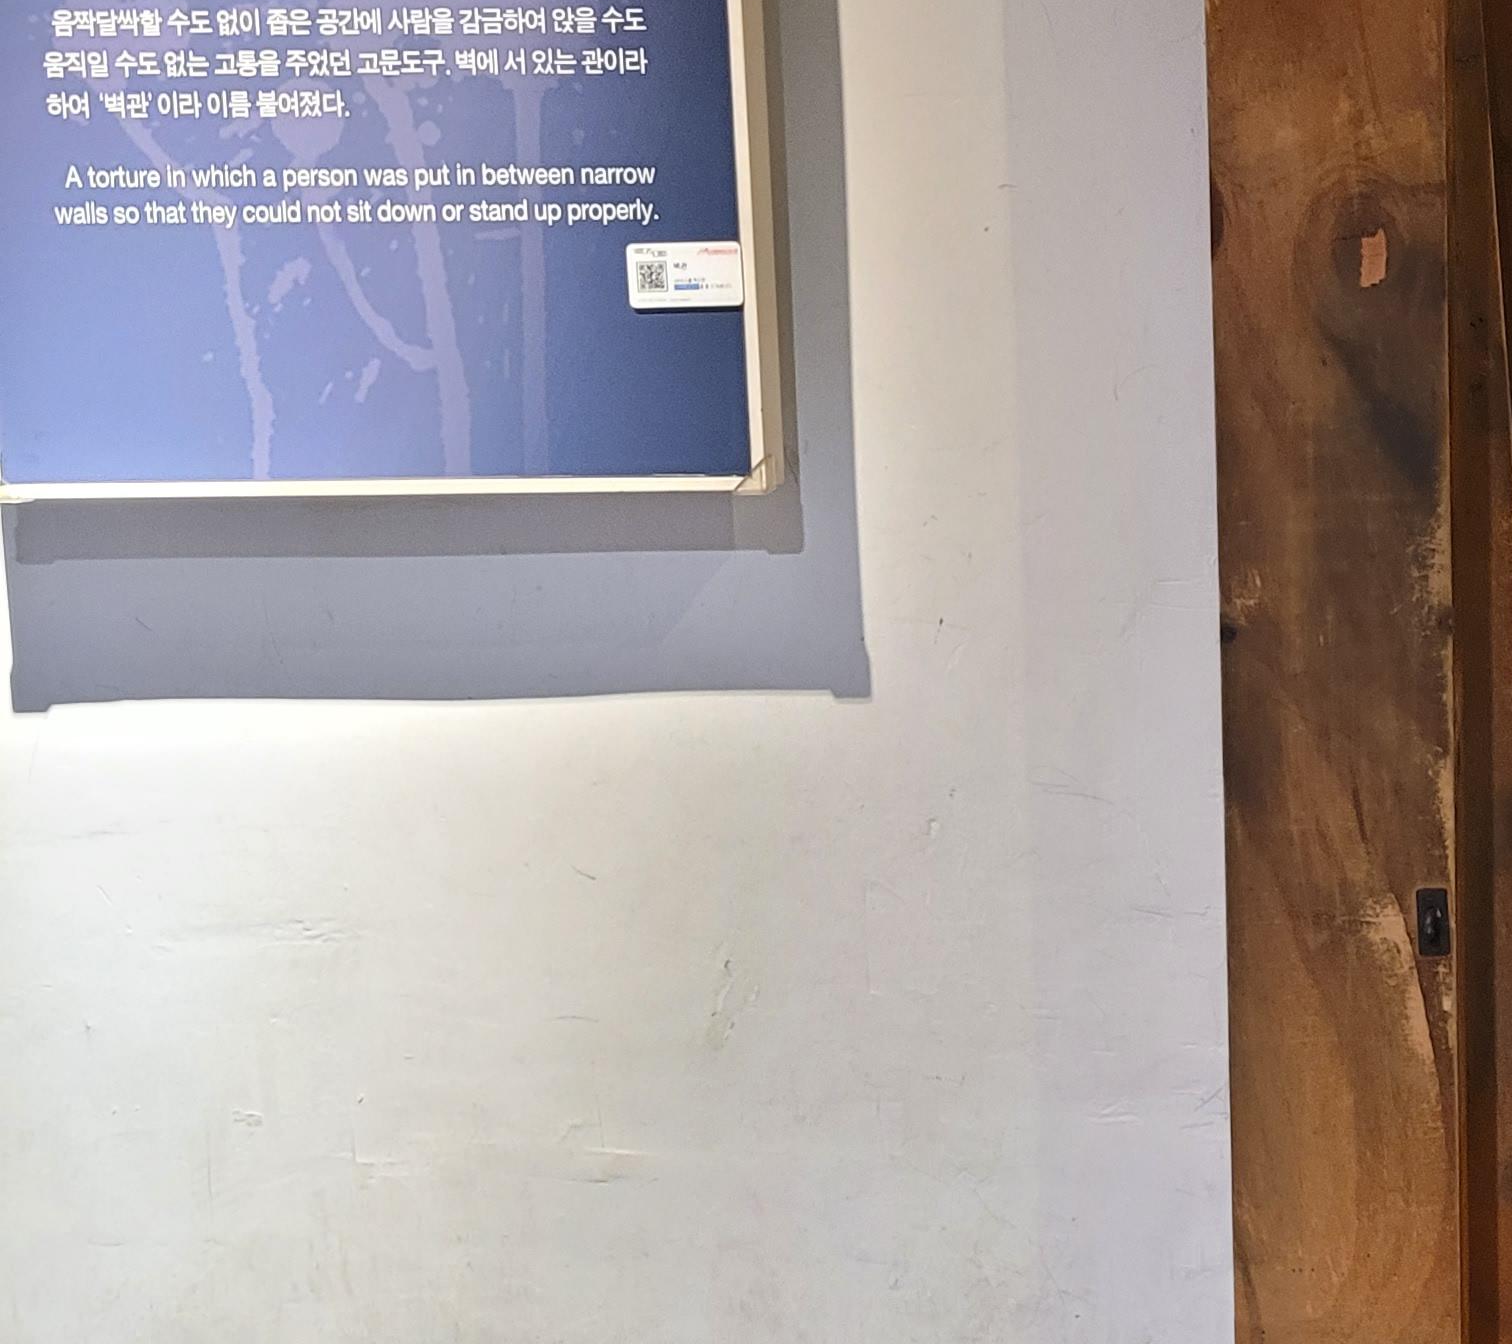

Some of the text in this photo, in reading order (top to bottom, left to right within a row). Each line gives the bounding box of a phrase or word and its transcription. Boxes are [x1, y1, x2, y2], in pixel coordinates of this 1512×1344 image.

[51, 5, 648, 38] 옴짝달싹할 수도 없이 좁은 공간에 사람을 감금하여 앉을 수도
[42, 46, 649, 79] 움직일 수도 없는 고통을 주었던 고문도구. 벽에 서 있는 관이라
[45, 90, 90, 121] 하여
[206, 89, 253, 119] 이름
[255, 89, 351, 118] 붙여졌다.
[64, 162, 657, 192] A torture in which a person was put in between narrow
[53, 197, 660, 229] walls so that they could not sit down or stand up properly.
